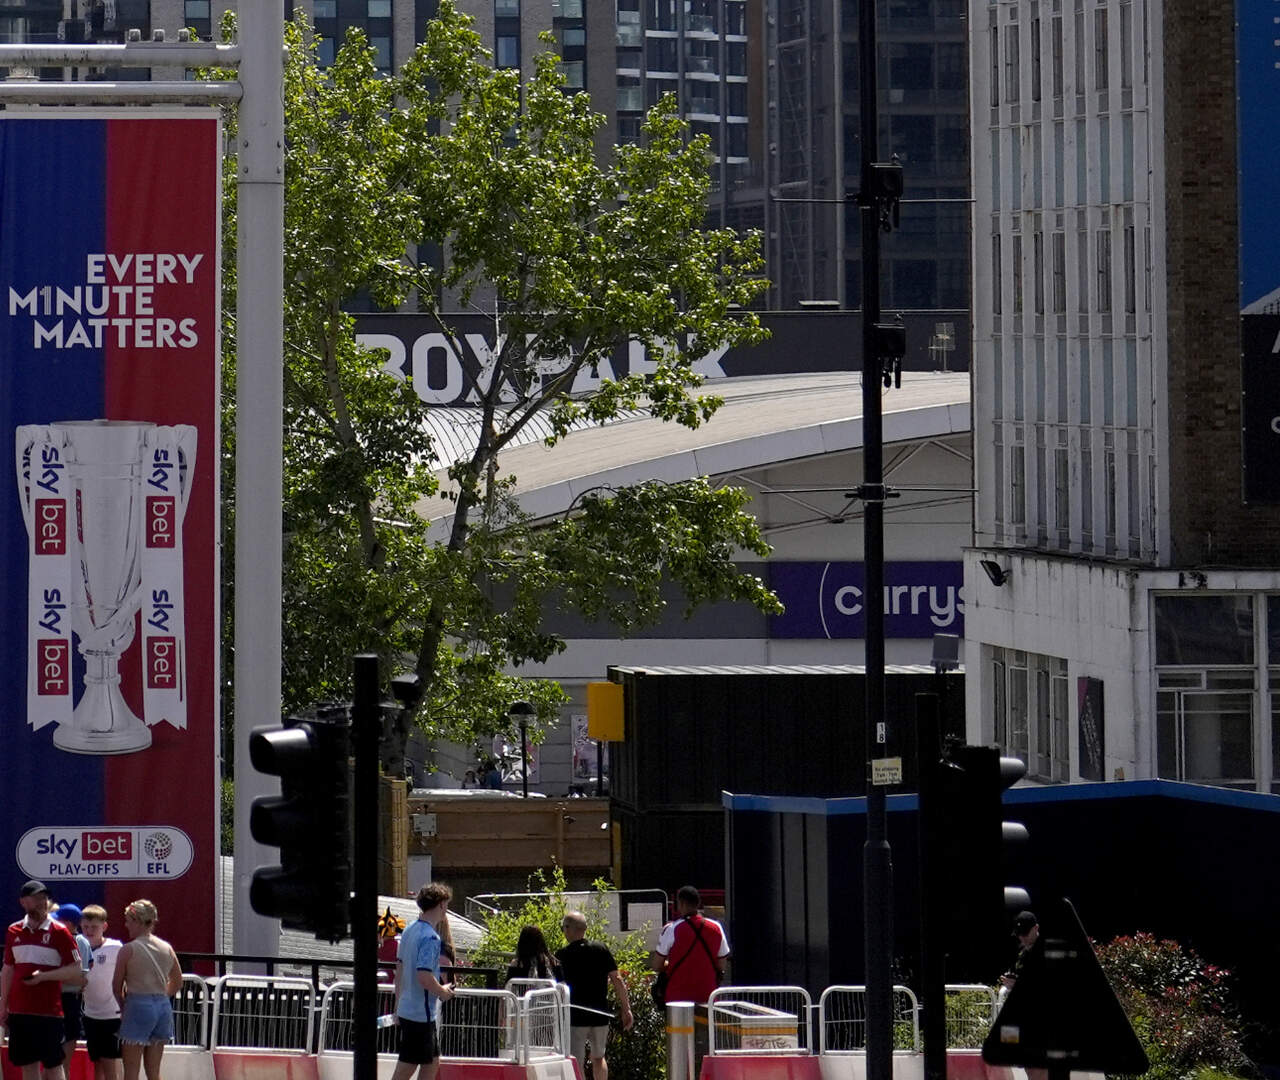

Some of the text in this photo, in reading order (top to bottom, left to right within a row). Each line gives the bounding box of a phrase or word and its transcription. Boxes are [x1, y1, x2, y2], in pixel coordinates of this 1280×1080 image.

[87, 253, 204, 284] EVERY
[34, 318, 198, 349] MATTERS
[36, 446, 64, 550] sky bet
[147, 449, 173, 543] sky bet
[39, 588, 67, 690] sky bet
[148, 589, 173, 684] sky bet
[36, 834, 128, 859] sky bet
[49, 863, 120, 875] PLAY-OFFS
[147, 863, 170, 874] EFL
